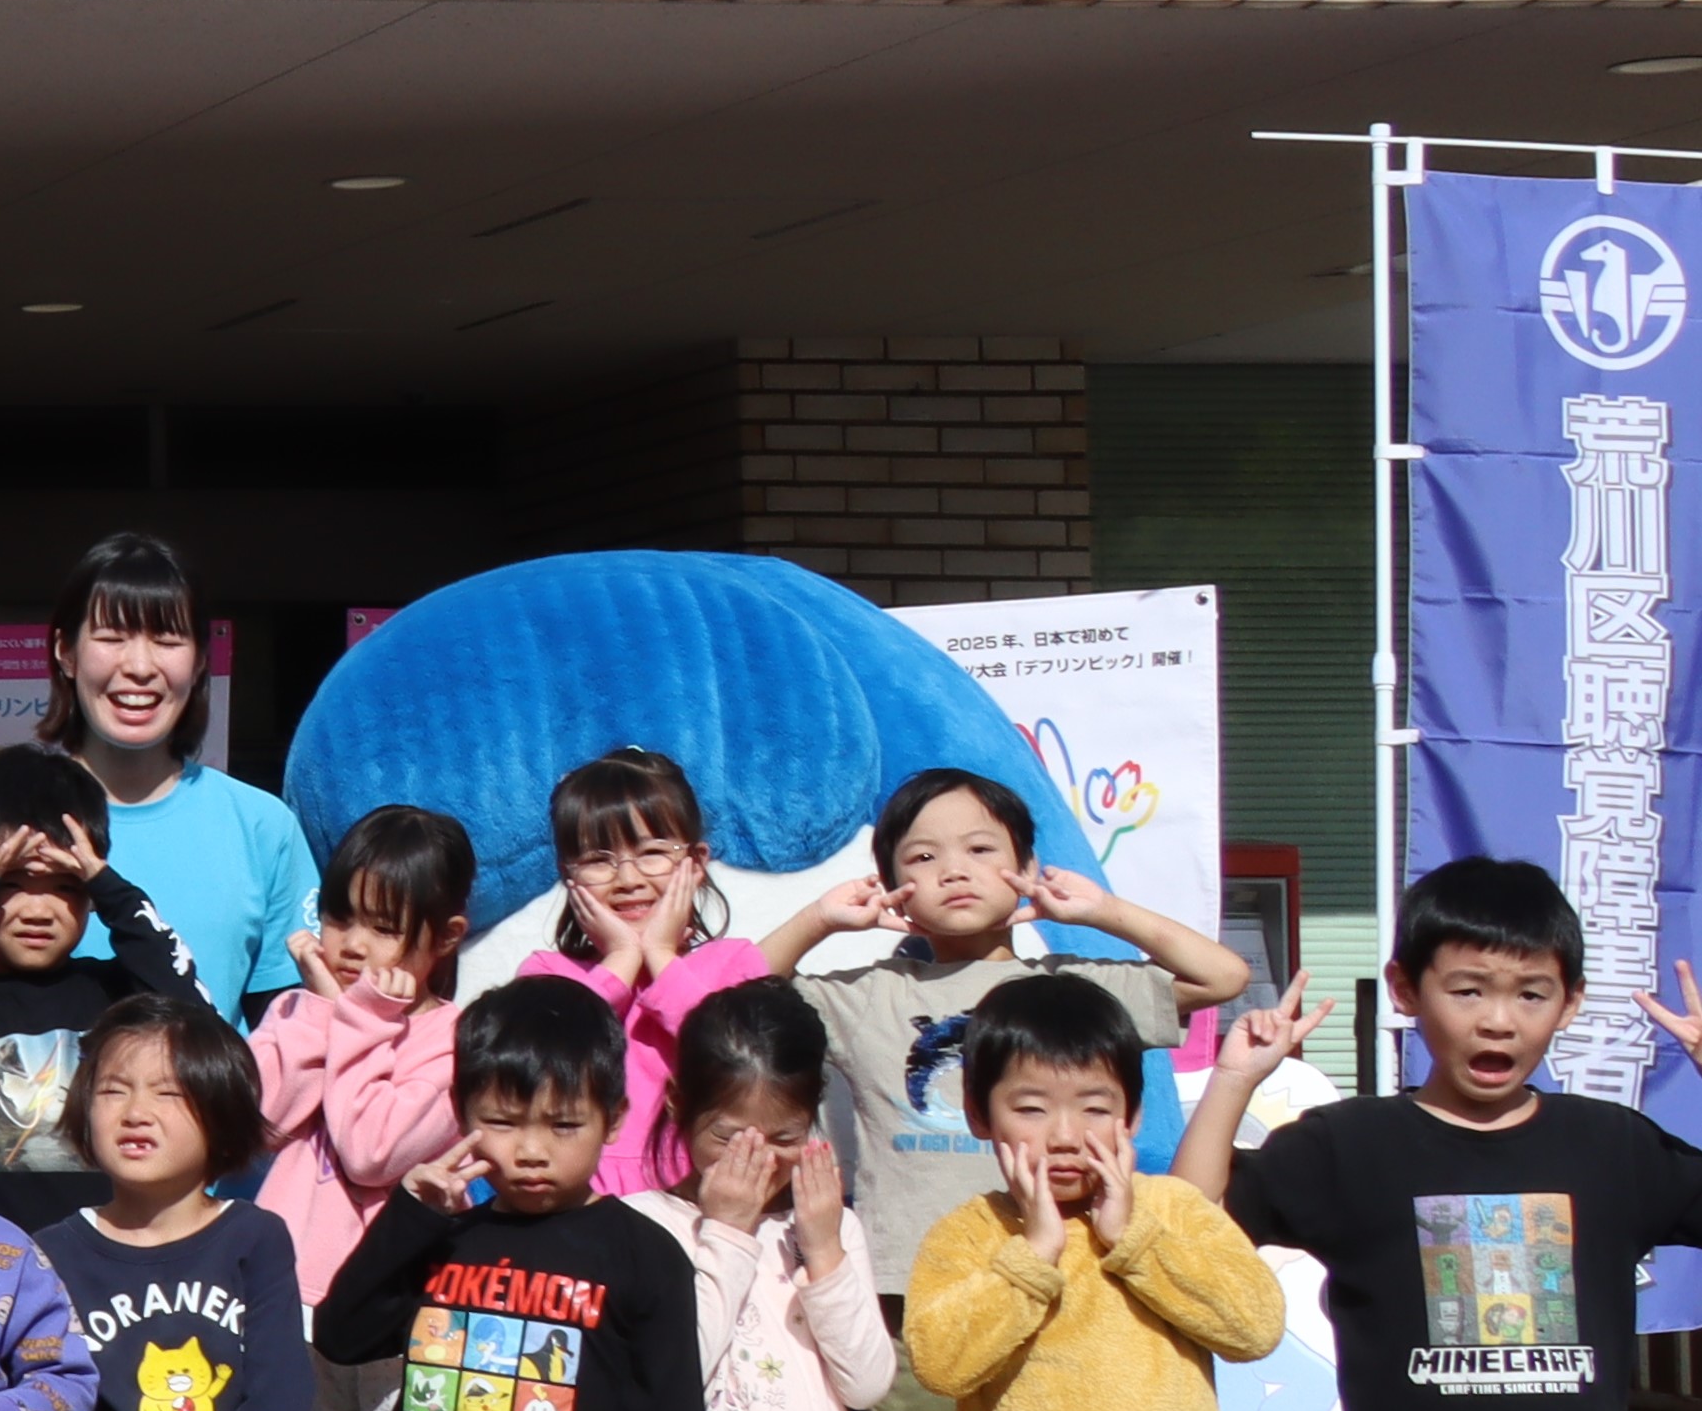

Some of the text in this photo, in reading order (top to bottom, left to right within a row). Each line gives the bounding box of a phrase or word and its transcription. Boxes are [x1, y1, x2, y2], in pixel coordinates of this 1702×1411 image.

[1408, 1346, 1595, 1384] MINECRAFT
[1440, 1382, 1502, 1395] CRAFTING
[1504, 1382, 1543, 1394] SINCE
